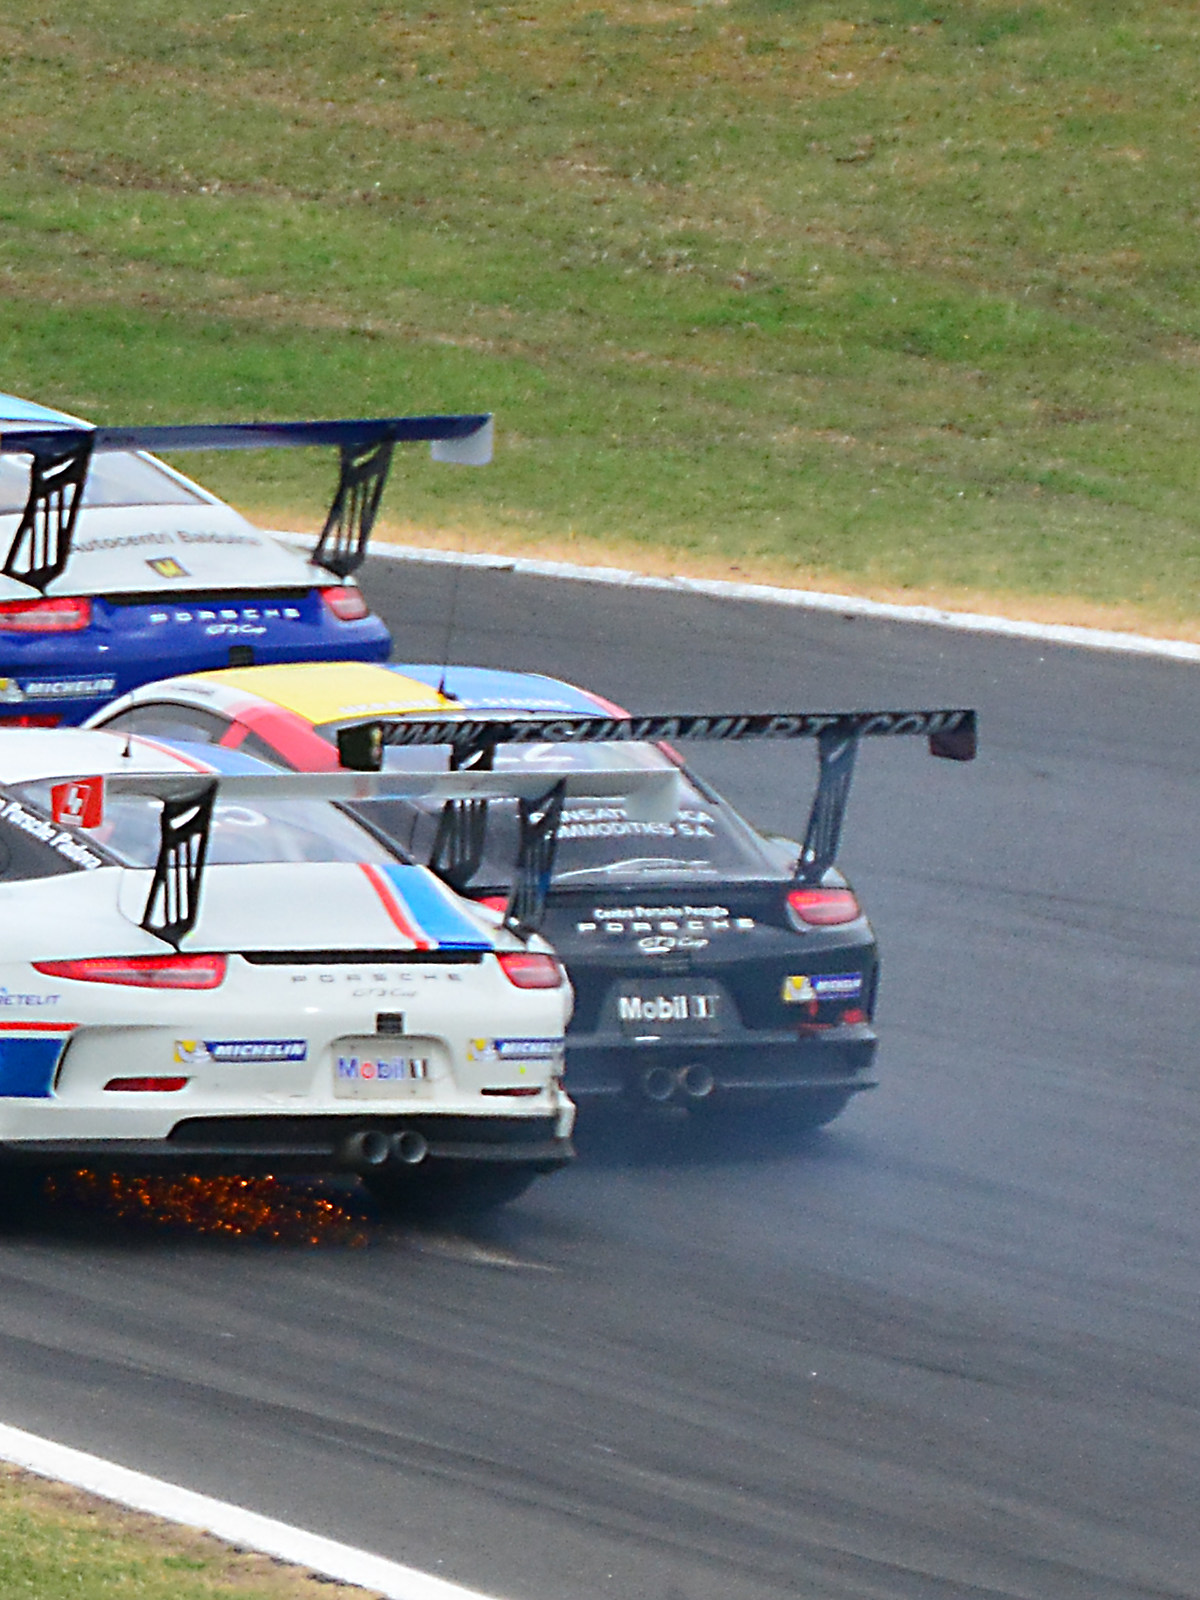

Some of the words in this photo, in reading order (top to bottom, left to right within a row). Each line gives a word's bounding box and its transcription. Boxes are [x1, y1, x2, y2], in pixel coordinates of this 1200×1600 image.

[150, 607, 300, 623] PORSCHE
[0, 801, 57, 841] Porsche
[577, 917, 755, 932] PORSCHE
[291, 973, 462, 984] PORSCHE
[619, 995, 688, 1019] Mobil
[213, 1044, 305, 1057] MICHELIN
[337, 1056, 405, 1080] Mobil
